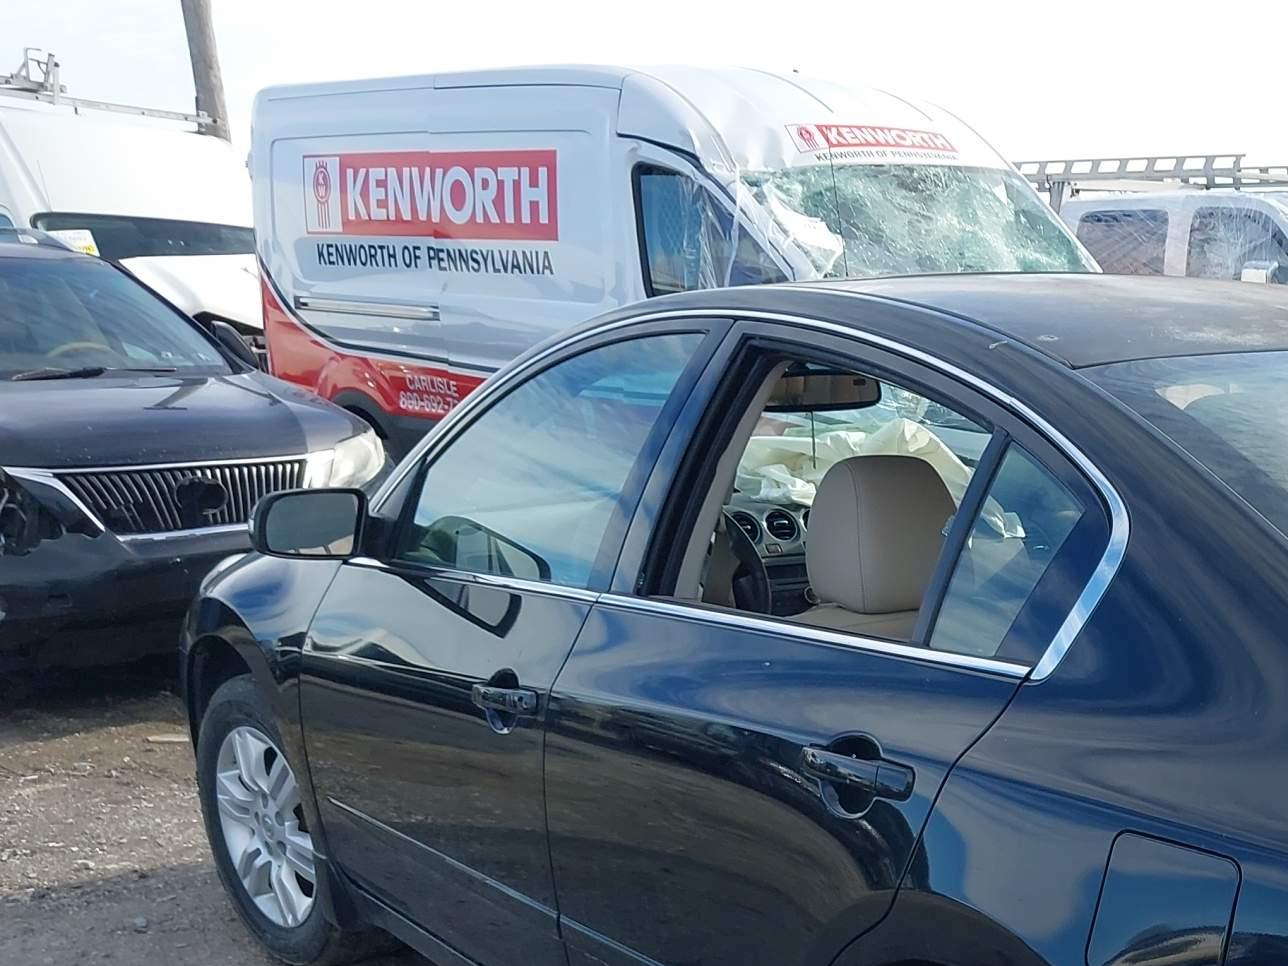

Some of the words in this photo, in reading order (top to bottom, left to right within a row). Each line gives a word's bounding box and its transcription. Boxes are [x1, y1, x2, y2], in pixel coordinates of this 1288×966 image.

[828, 127, 948, 148] KENWORTH
[815, 150, 874, 161] KENWORTH
[346, 165, 549, 225] KENWORTH
[316, 243, 398, 268] KENWORTH
[402, 245, 422, 268] OF
[427, 246, 554, 275] PENNSYLVANIA
[405, 374, 460, 398] CARLISLE
